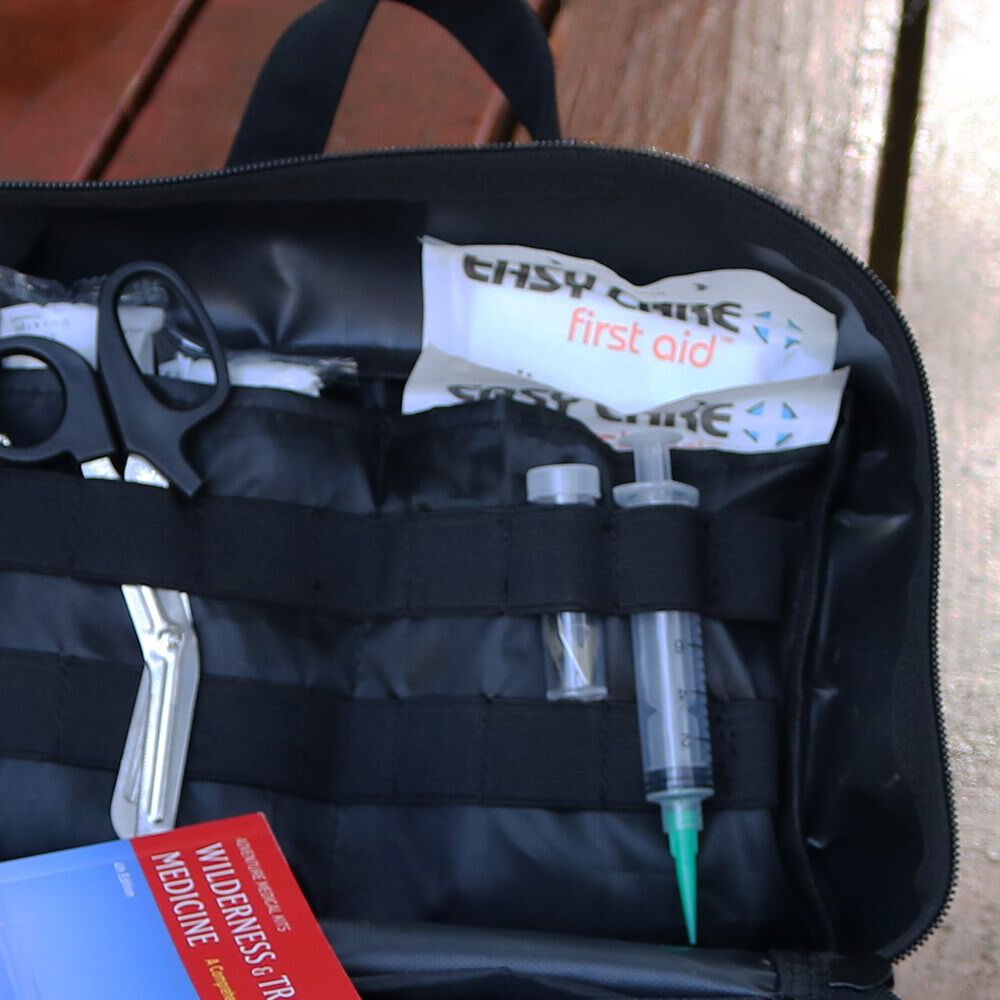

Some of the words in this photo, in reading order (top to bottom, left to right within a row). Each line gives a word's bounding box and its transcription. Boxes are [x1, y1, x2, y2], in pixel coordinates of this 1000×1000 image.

[567, 306, 644, 355] first
[652, 330, 718, 369] aid
[151, 850, 220, 948] MEDICINE
[195, 842, 276, 966] WILDERNESS
[251, 966, 274, 977] &
